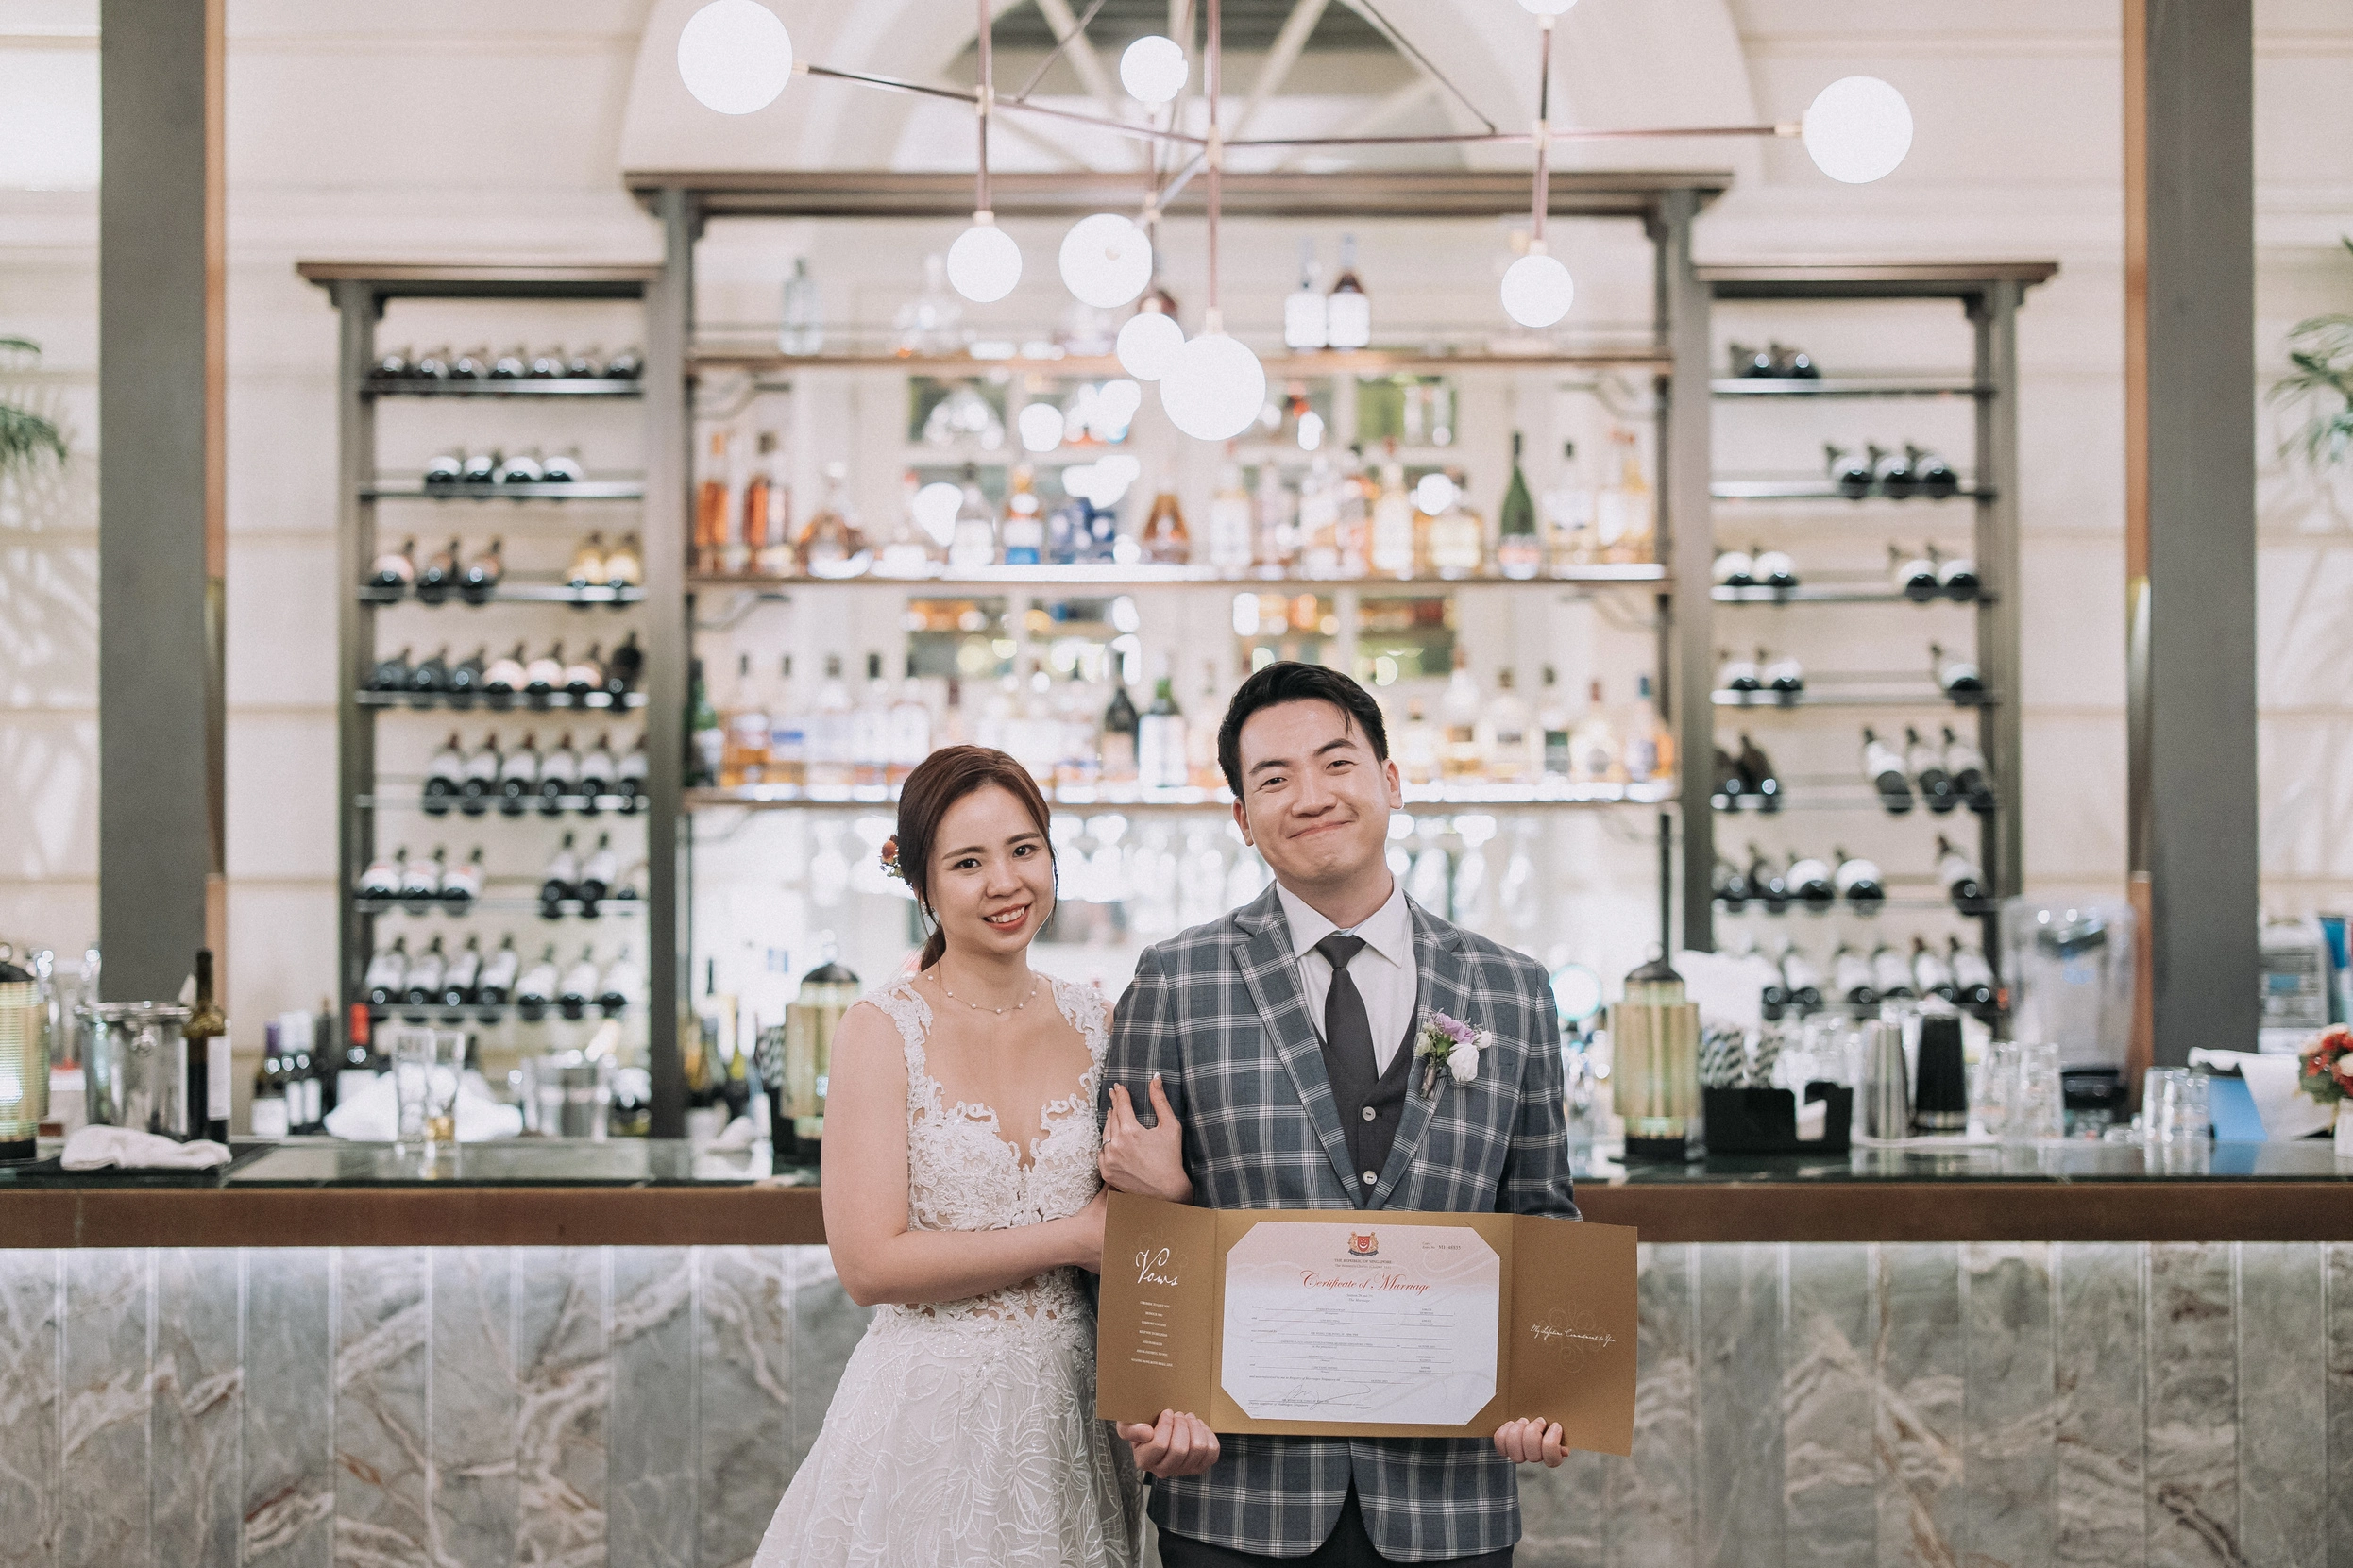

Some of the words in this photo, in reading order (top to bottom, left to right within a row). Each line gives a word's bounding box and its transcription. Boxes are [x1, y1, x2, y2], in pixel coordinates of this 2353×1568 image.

[1135, 1247, 1178, 1287] Vows
[1300, 1270, 1358, 1291] Certificate
[1358, 1277, 1371, 1292] of
[1370, 1272, 1431, 1296] Marriage
[1530, 1324, 1540, 1339] My
